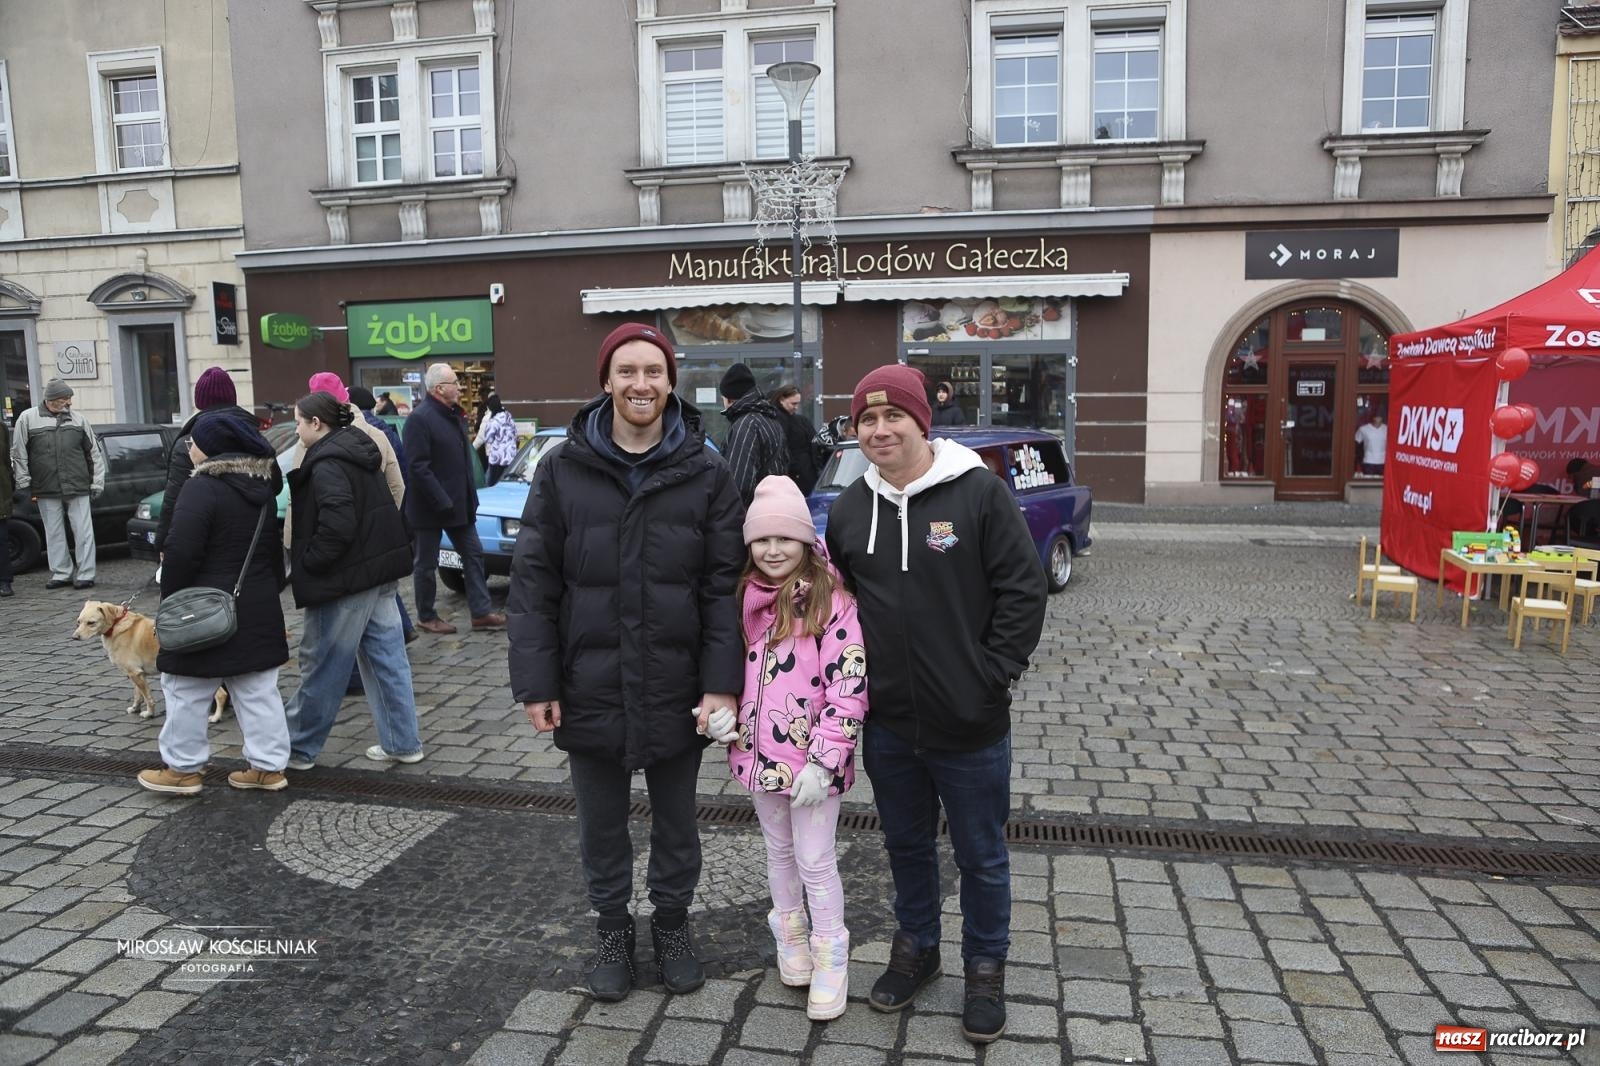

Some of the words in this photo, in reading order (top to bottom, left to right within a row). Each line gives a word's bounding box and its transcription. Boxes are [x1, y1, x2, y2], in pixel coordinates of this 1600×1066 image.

[842, 243, 935, 276] Lodów
[946, 237, 1068, 272] Gałeczka
[1300, 248, 1375, 260] MORAJ
[272, 320, 308, 337] żabka
[367, 312, 472, 345] żabka
[1424, 337, 1457, 356] Dawcą
[1398, 405, 1446, 451] DKMS
